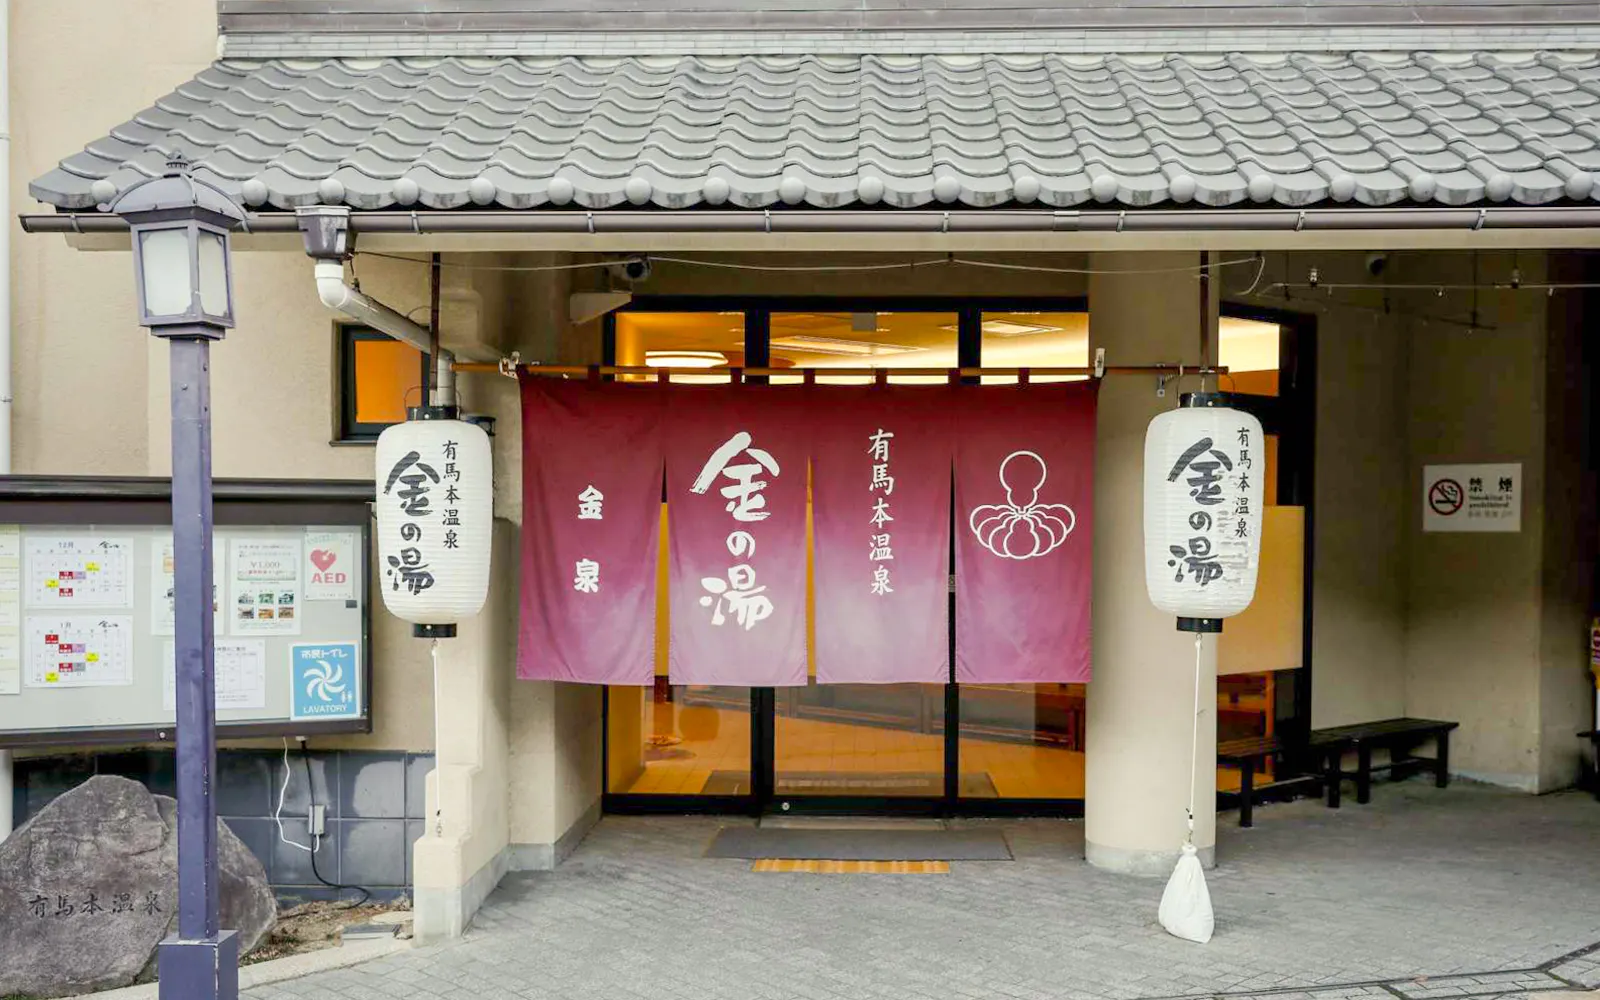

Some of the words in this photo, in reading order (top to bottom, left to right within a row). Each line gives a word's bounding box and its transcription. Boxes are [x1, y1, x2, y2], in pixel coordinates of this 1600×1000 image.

[384, 450, 441, 596] 金の湯
[442, 439, 461, 549] 有馬本温泉
[688, 431, 781, 631] 金の湯
[867, 428, 895, 596] 有馬本温泉
[1166, 436, 1233, 586] 金の湯
[1234, 426, 1252, 538] 有馬本温泉
[311, 572, 347, 584] AED
[573, 485, 604, 593] 金泉
[303, 704, 347, 714] LAVATORY
[28, 890, 162, 919] 有馬本温泉
